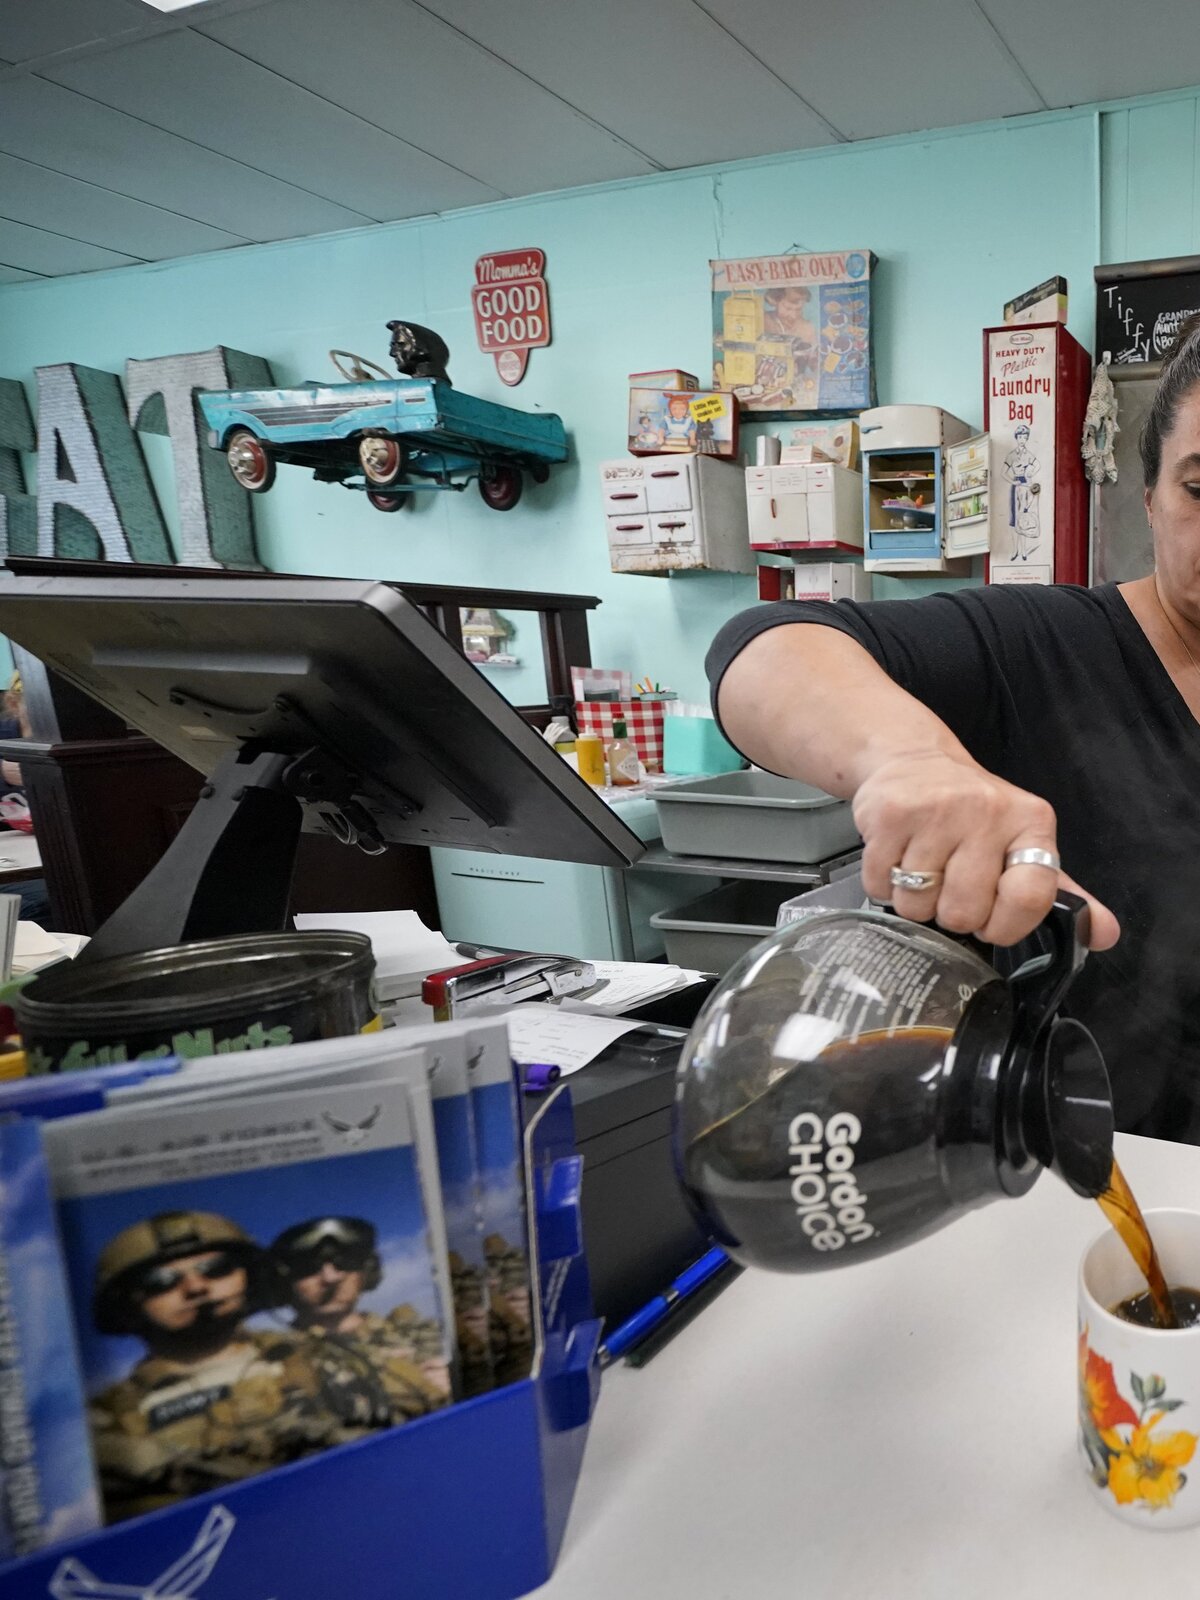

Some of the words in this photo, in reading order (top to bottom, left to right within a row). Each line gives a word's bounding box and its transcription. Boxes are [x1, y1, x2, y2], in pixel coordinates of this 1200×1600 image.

[479, 257, 538, 282] Momma's
[809, 255, 847, 278] OVEN
[476, 285, 541, 318] GOOD
[481, 315, 543, 345] FOOD
[995, 349, 1021, 358] HEAVY
[1023, 346, 1046, 356] DUTY
[1000, 356, 1037, 378] Plastic
[992, 374, 1051, 397] Laundry
[1008, 400, 1033, 426] Bag
[825, 1111, 875, 1243] Gordon
